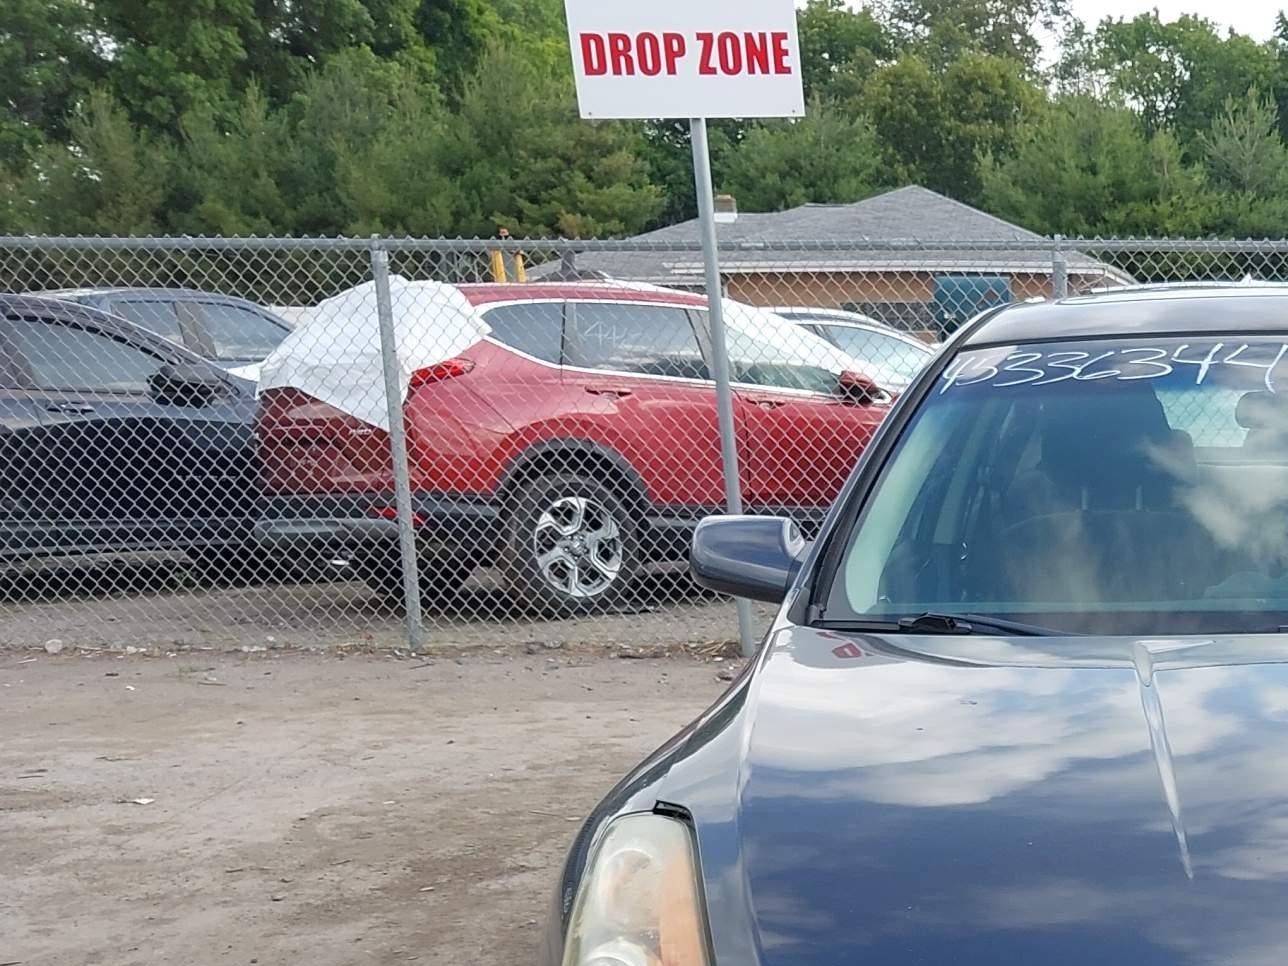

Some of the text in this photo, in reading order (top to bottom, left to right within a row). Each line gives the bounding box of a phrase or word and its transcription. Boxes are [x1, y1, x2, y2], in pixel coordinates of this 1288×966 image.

[579, 31, 792, 76] DROP ZONE
[939, 343, 1288, 394] 45336344
